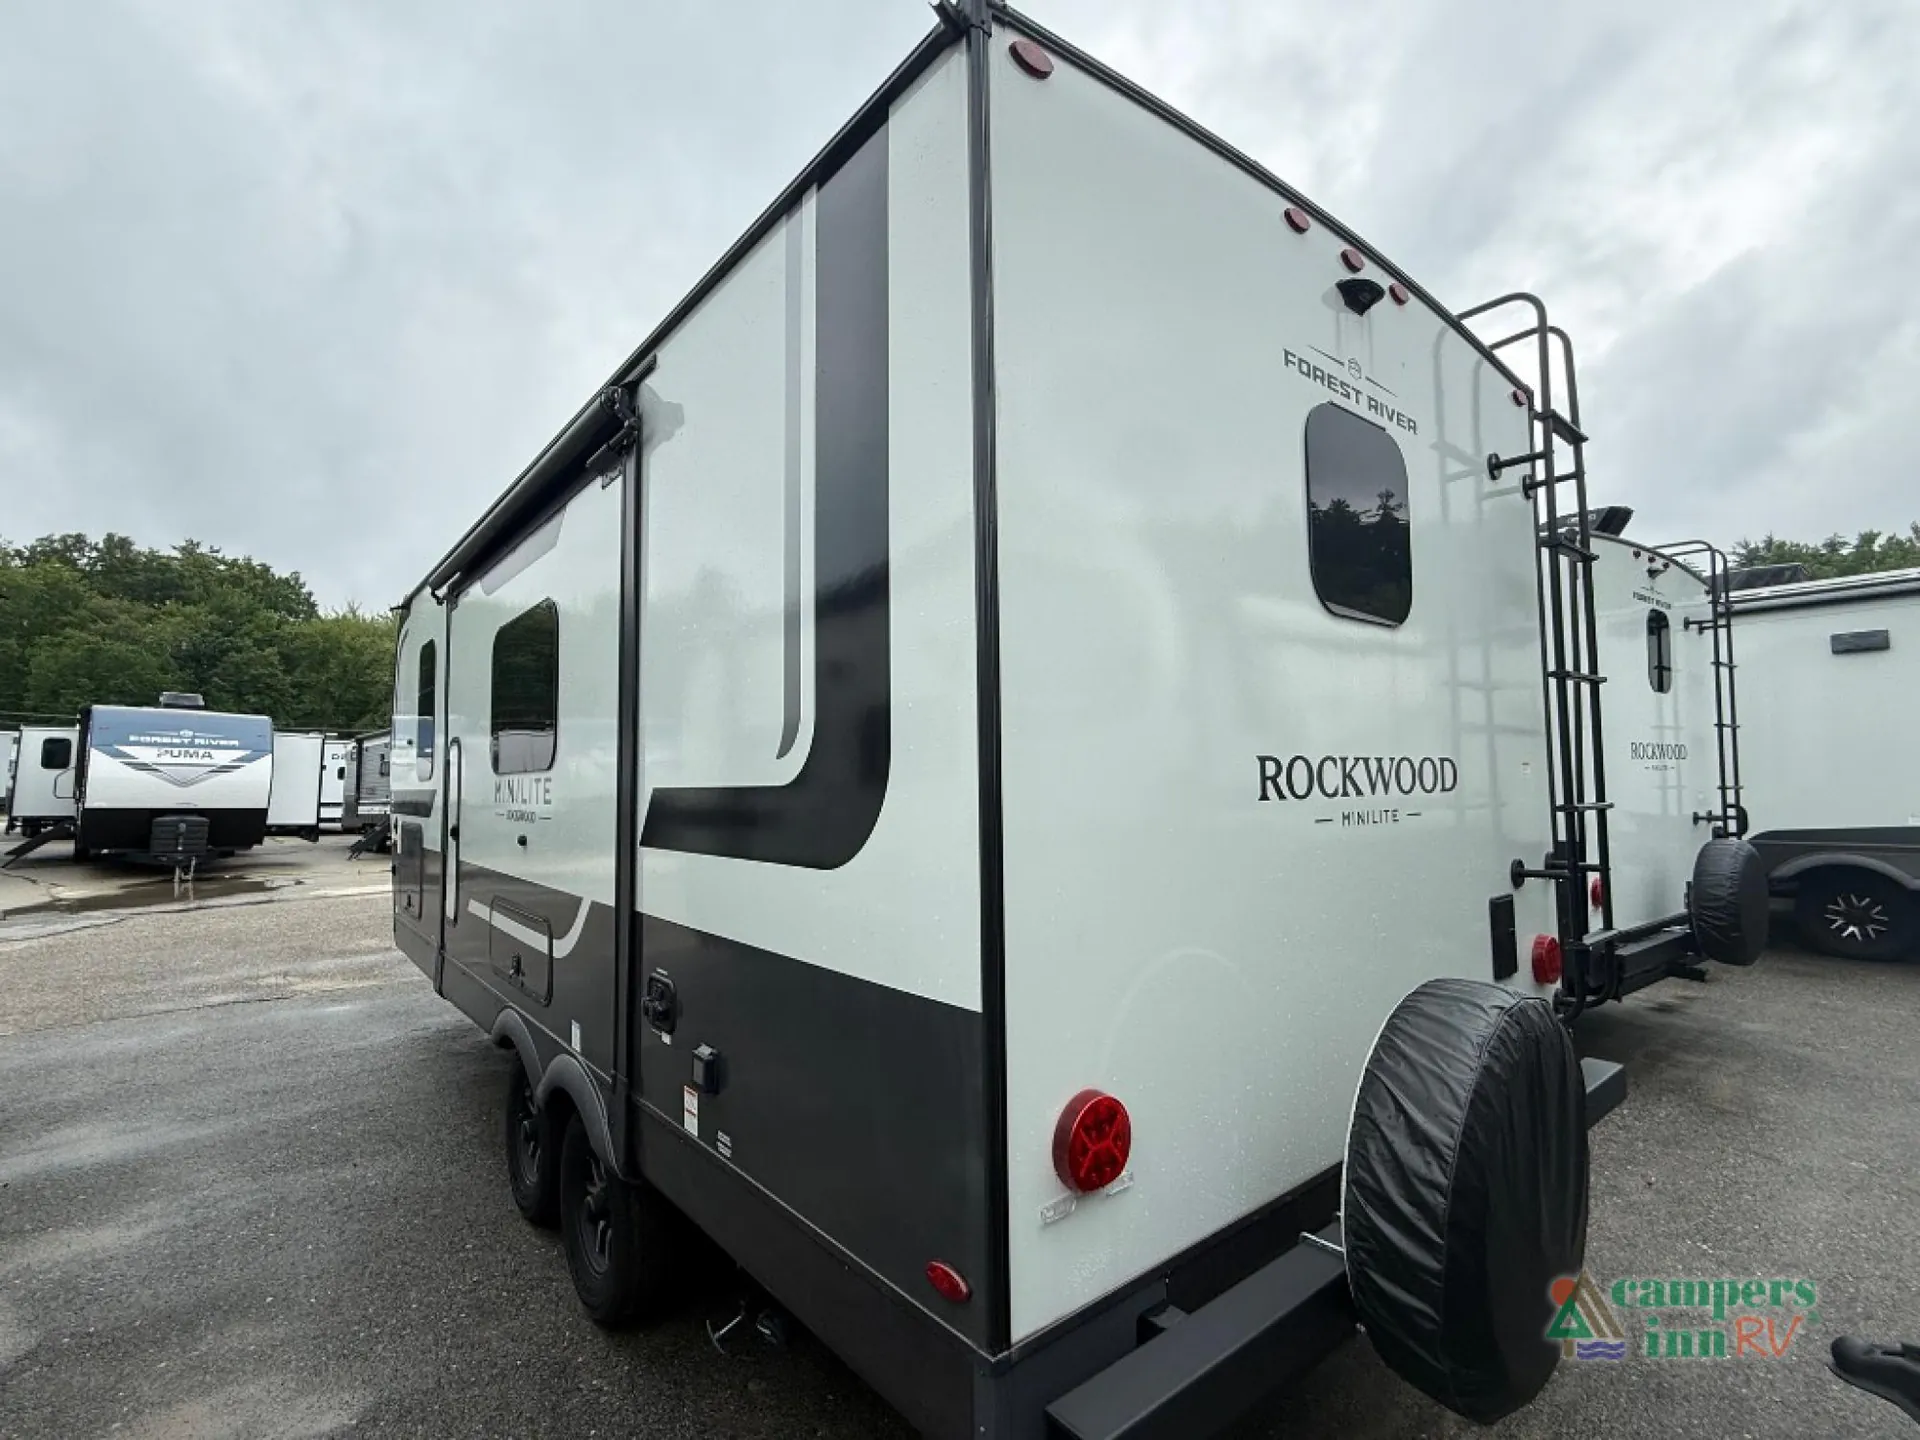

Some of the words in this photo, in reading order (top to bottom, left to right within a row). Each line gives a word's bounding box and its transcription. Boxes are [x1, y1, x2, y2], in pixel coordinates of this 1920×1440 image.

[1283, 348, 1363, 405] FOREST
[1367, 394, 1418, 435] RIVER
[129, 734, 192, 744] FOREST
[194, 738, 239, 747] RIVER
[157, 747, 214, 760] PUMA
[1630, 741, 1688, 760] ROCKWOOD
[1256, 755, 1458, 801] ROCKWOOD
[494, 777, 552, 805] MINILITE
[1341, 809, 1400, 827] MINILITE
